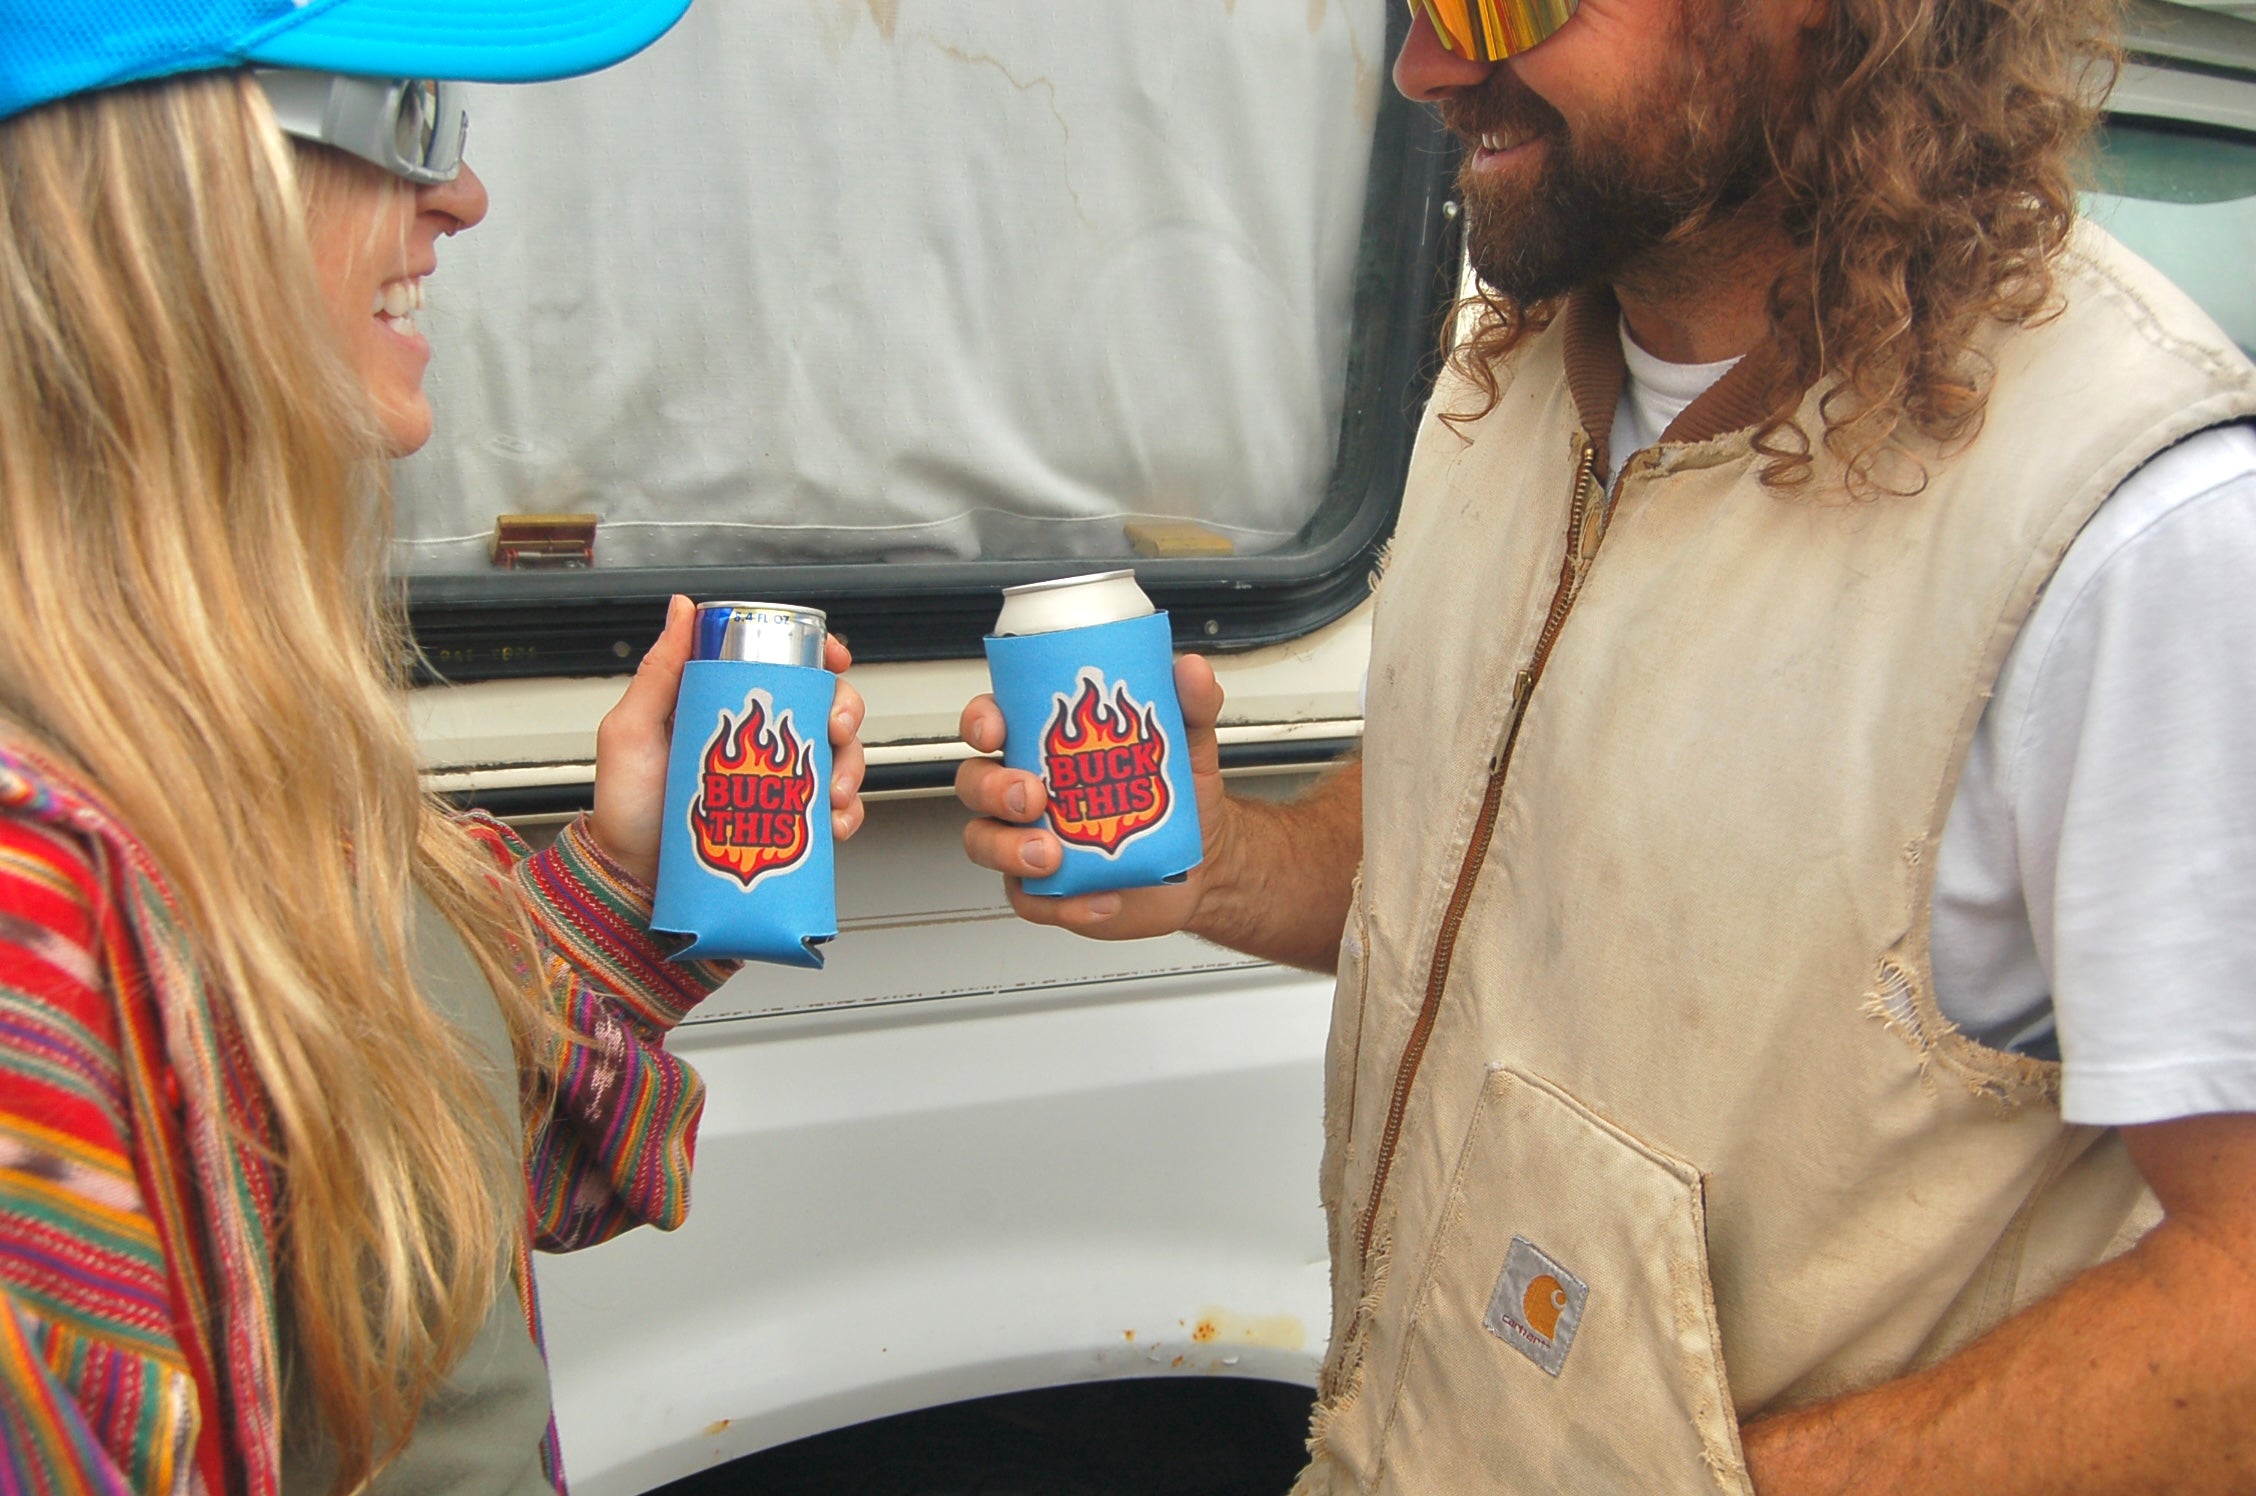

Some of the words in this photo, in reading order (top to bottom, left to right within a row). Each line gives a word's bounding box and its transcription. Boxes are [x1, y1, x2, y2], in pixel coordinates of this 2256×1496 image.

[734, 611, 753, 622] 8.4
[757, 613, 769, 624] FL
[773, 614, 790, 625] OZ
[1049, 742, 1158, 788] BUCK
[705, 775, 805, 811] BUCK
[1060, 777, 1153, 819] THIS
[710, 811, 794, 845] THIS
